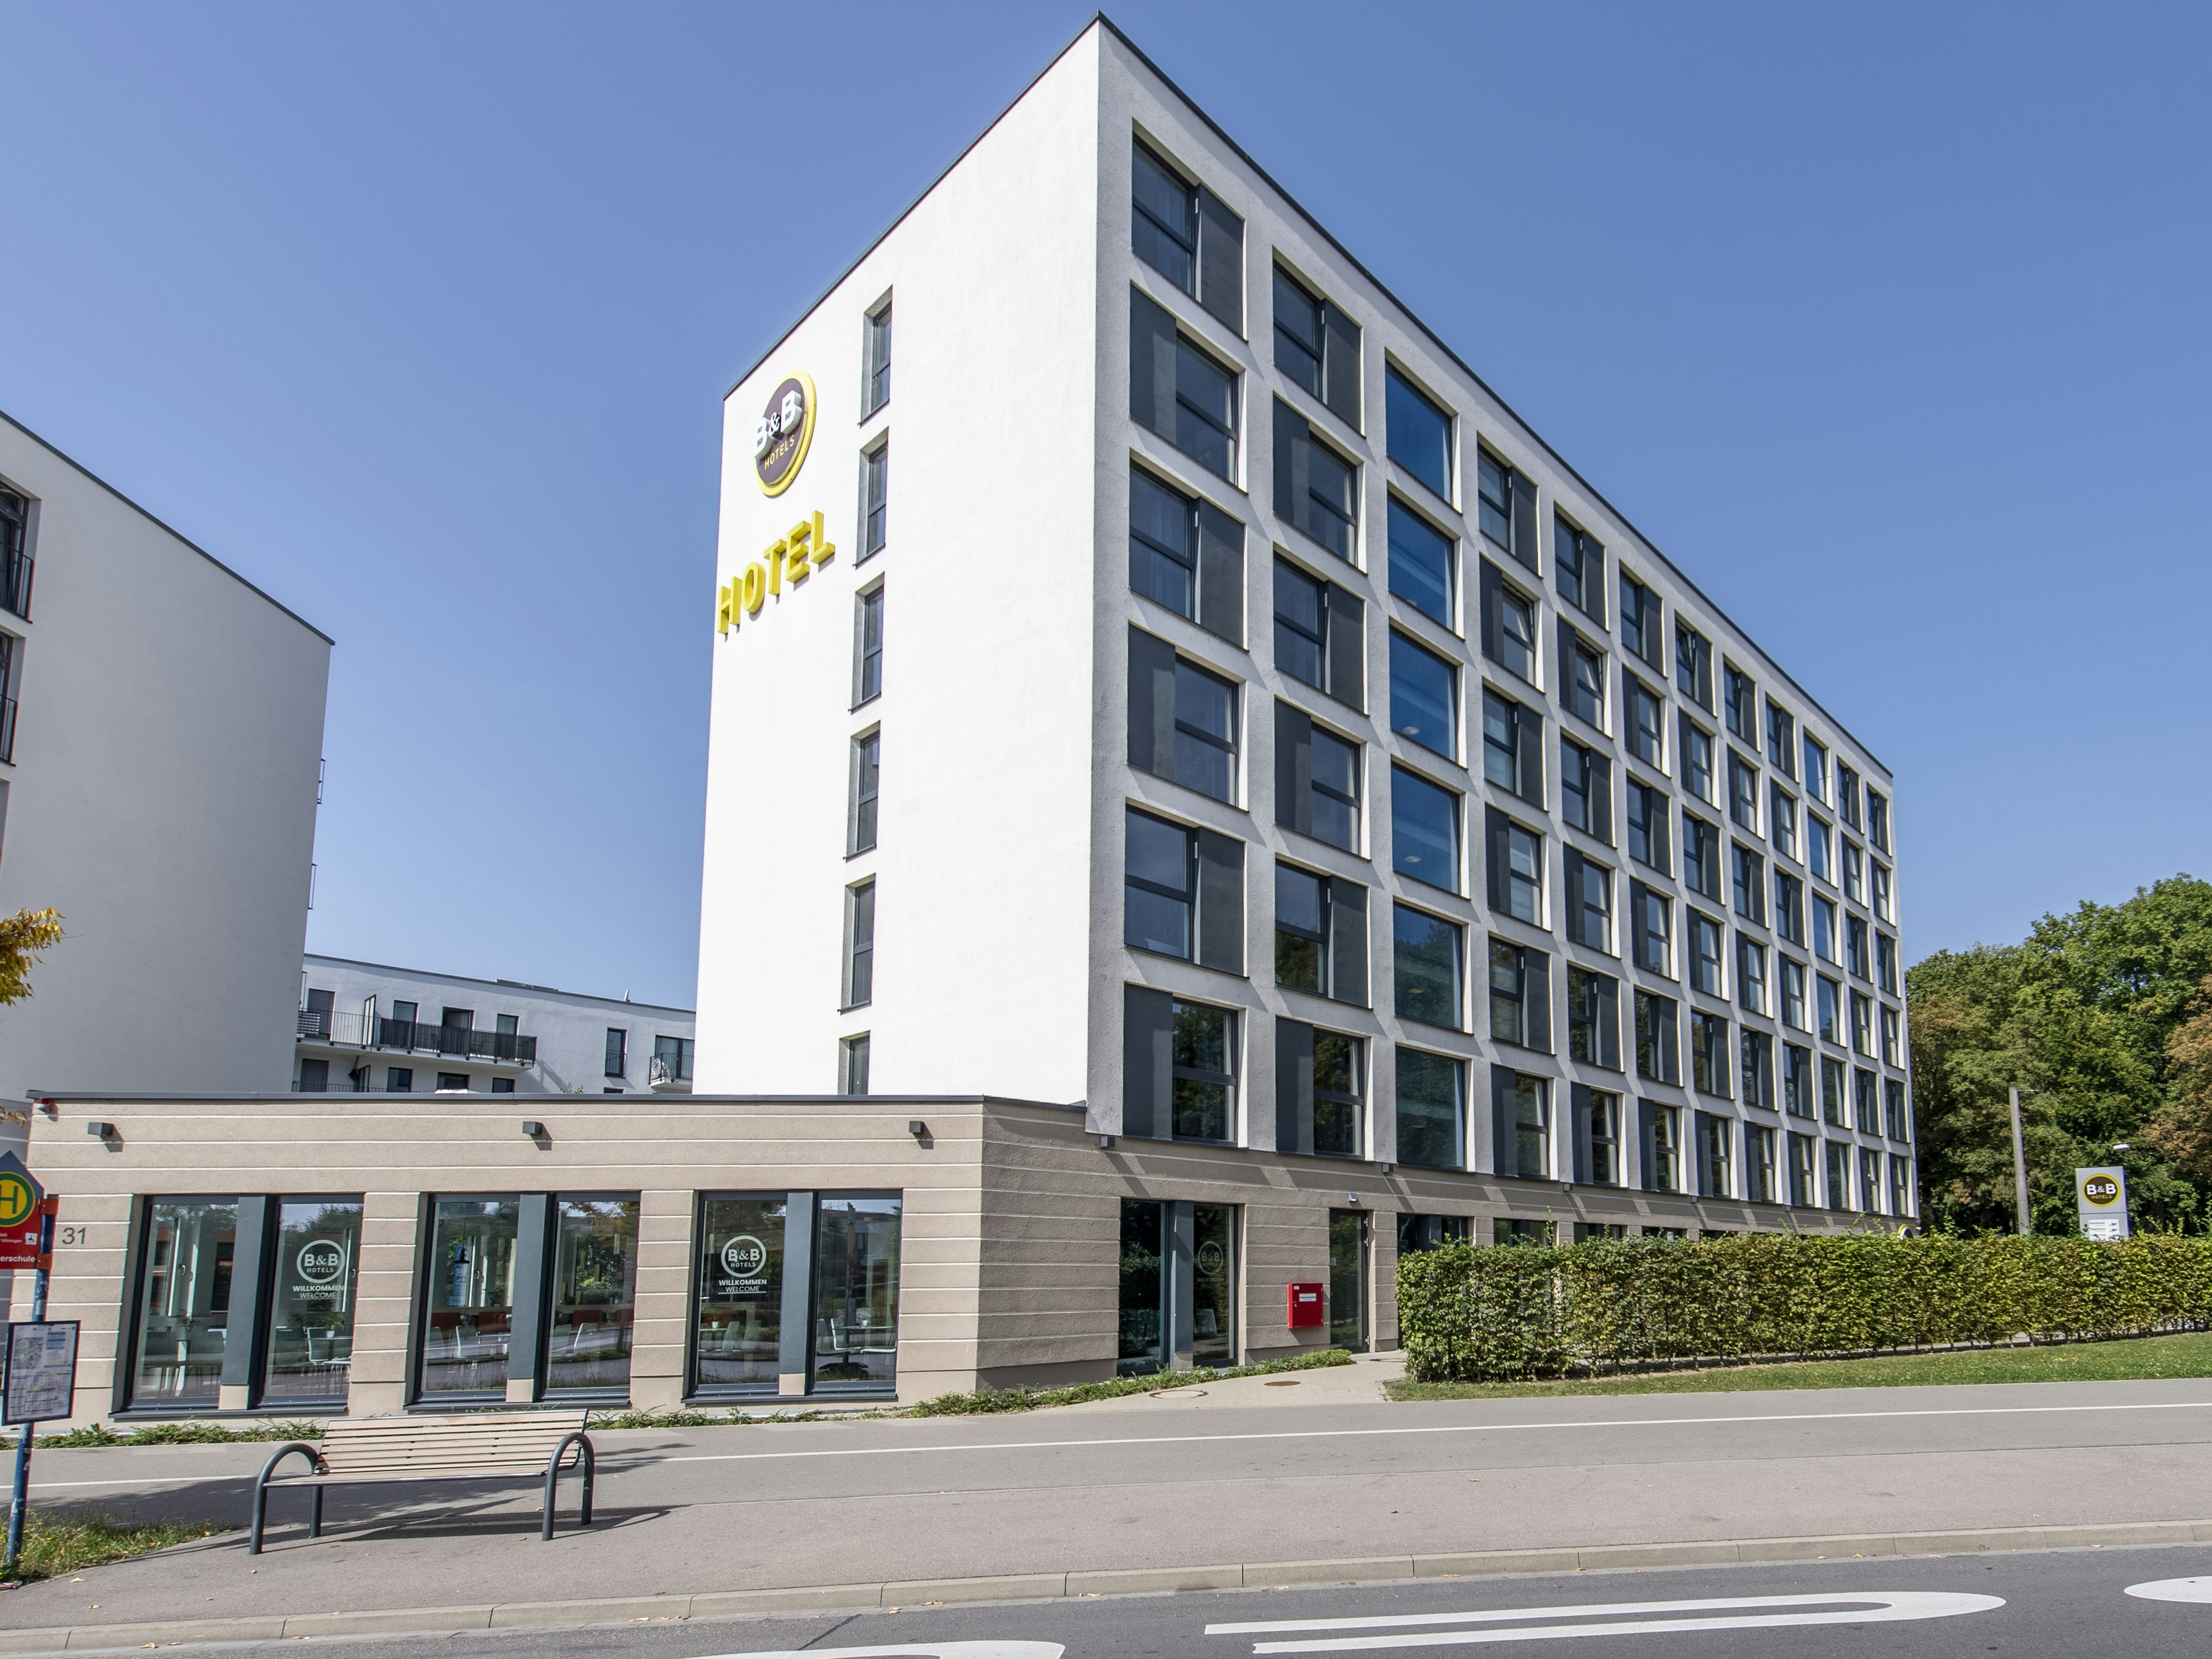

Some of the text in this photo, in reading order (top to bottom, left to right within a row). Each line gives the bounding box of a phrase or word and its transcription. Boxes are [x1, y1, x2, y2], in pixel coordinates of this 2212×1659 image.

[754, 390, 802, 460] B&B
[764, 435, 795, 470] HOTELS
[717, 510, 836, 634] HOTEL
[2086, 1183, 2116, 1195] B&B
[62, 1227, 86, 1245] 31
[304, 1254, 338, 1266] B&B
[728, 1249, 760, 1261] B&B
